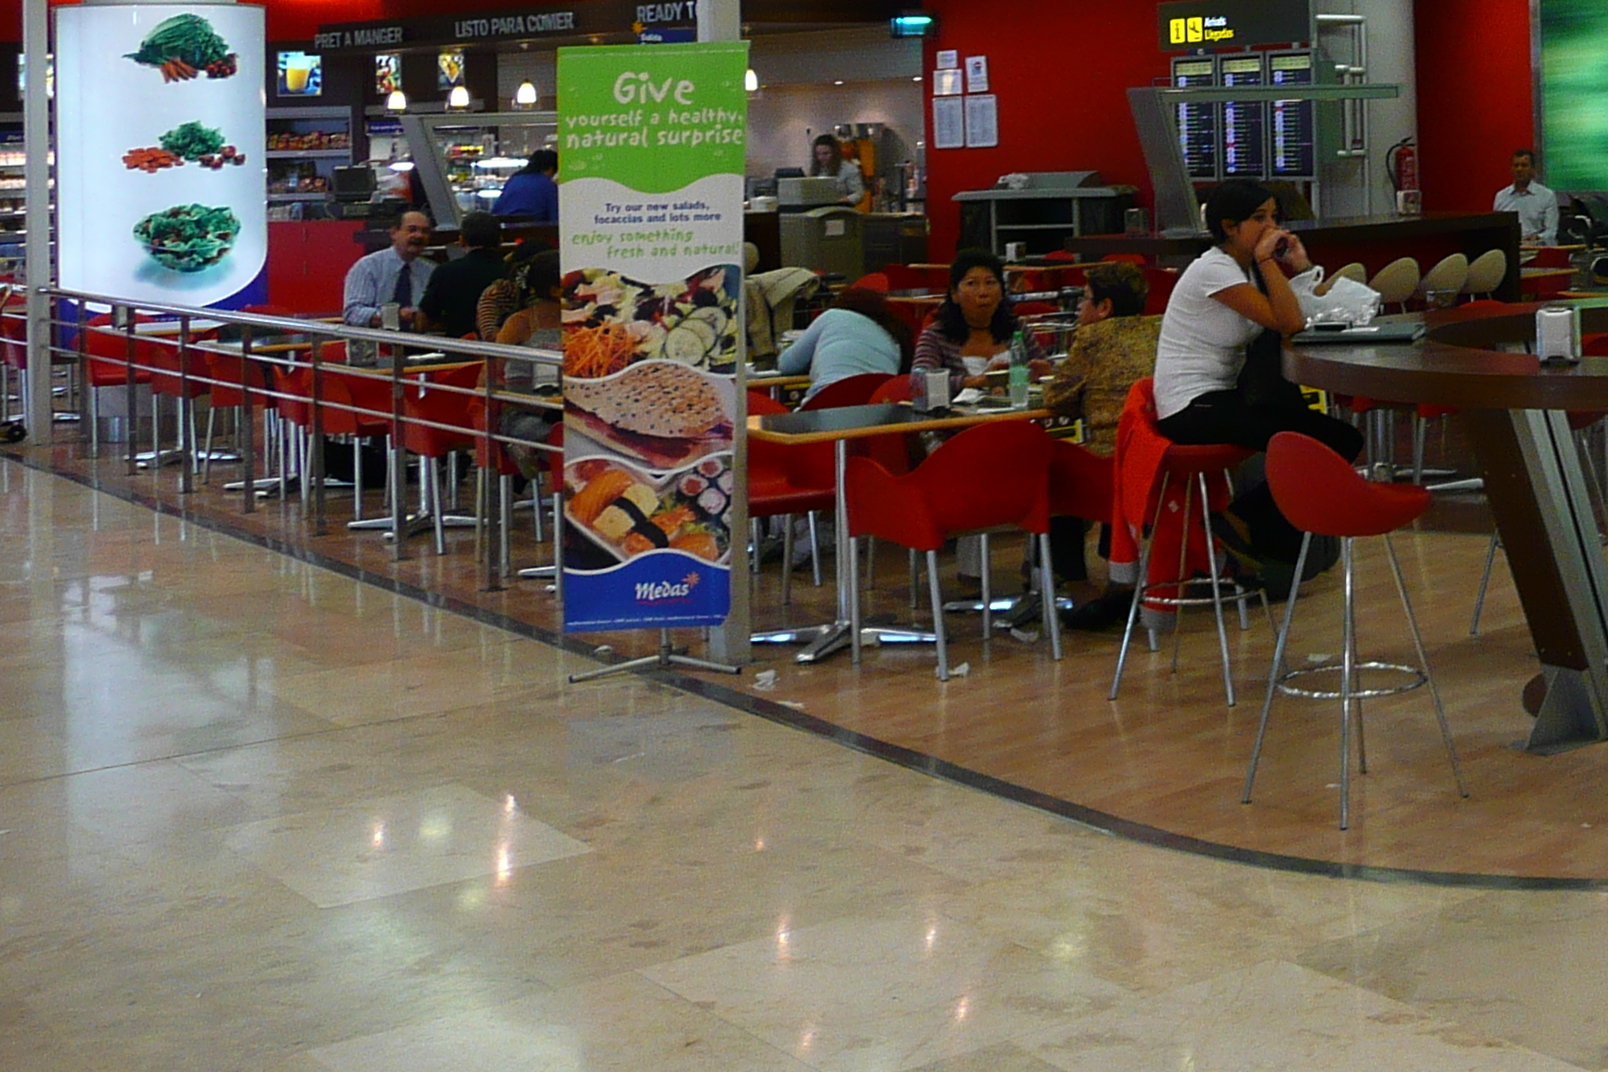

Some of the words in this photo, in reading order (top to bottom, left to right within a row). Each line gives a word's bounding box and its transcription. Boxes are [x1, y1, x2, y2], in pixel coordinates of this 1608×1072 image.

[636, 2, 683, 23] READY
[685, 1, 698, 19] T
[454, 20, 490, 38] LISTO
[491, 16, 525, 35] PARA
[527, 11, 575, 33] COMER
[314, 31, 342, 49] PRET
[344, 30, 351, 46] A
[354, 27, 403, 46] MANGER
[613, 71, 695, 105] Give
[565, 109, 643, 128] yourself
[650, 113, 660, 126] a
[566, 126, 648, 149] natural
[657, 124, 743, 148] surprise
[594, 215, 643, 224] focaccias
[647, 214, 666, 223] and
[669, 213, 690, 222] lots
[693, 213, 721, 221] more
[605, 203, 621, 214] Try
[625, 203, 642, 212] our
[647, 203, 668, 212] new
[572, 231, 612, 245] enjoy
[620, 228, 694, 243] something
[607, 245, 644, 259] fresh
[651, 245, 677, 257] and
[634, 580, 690, 601] Medas
